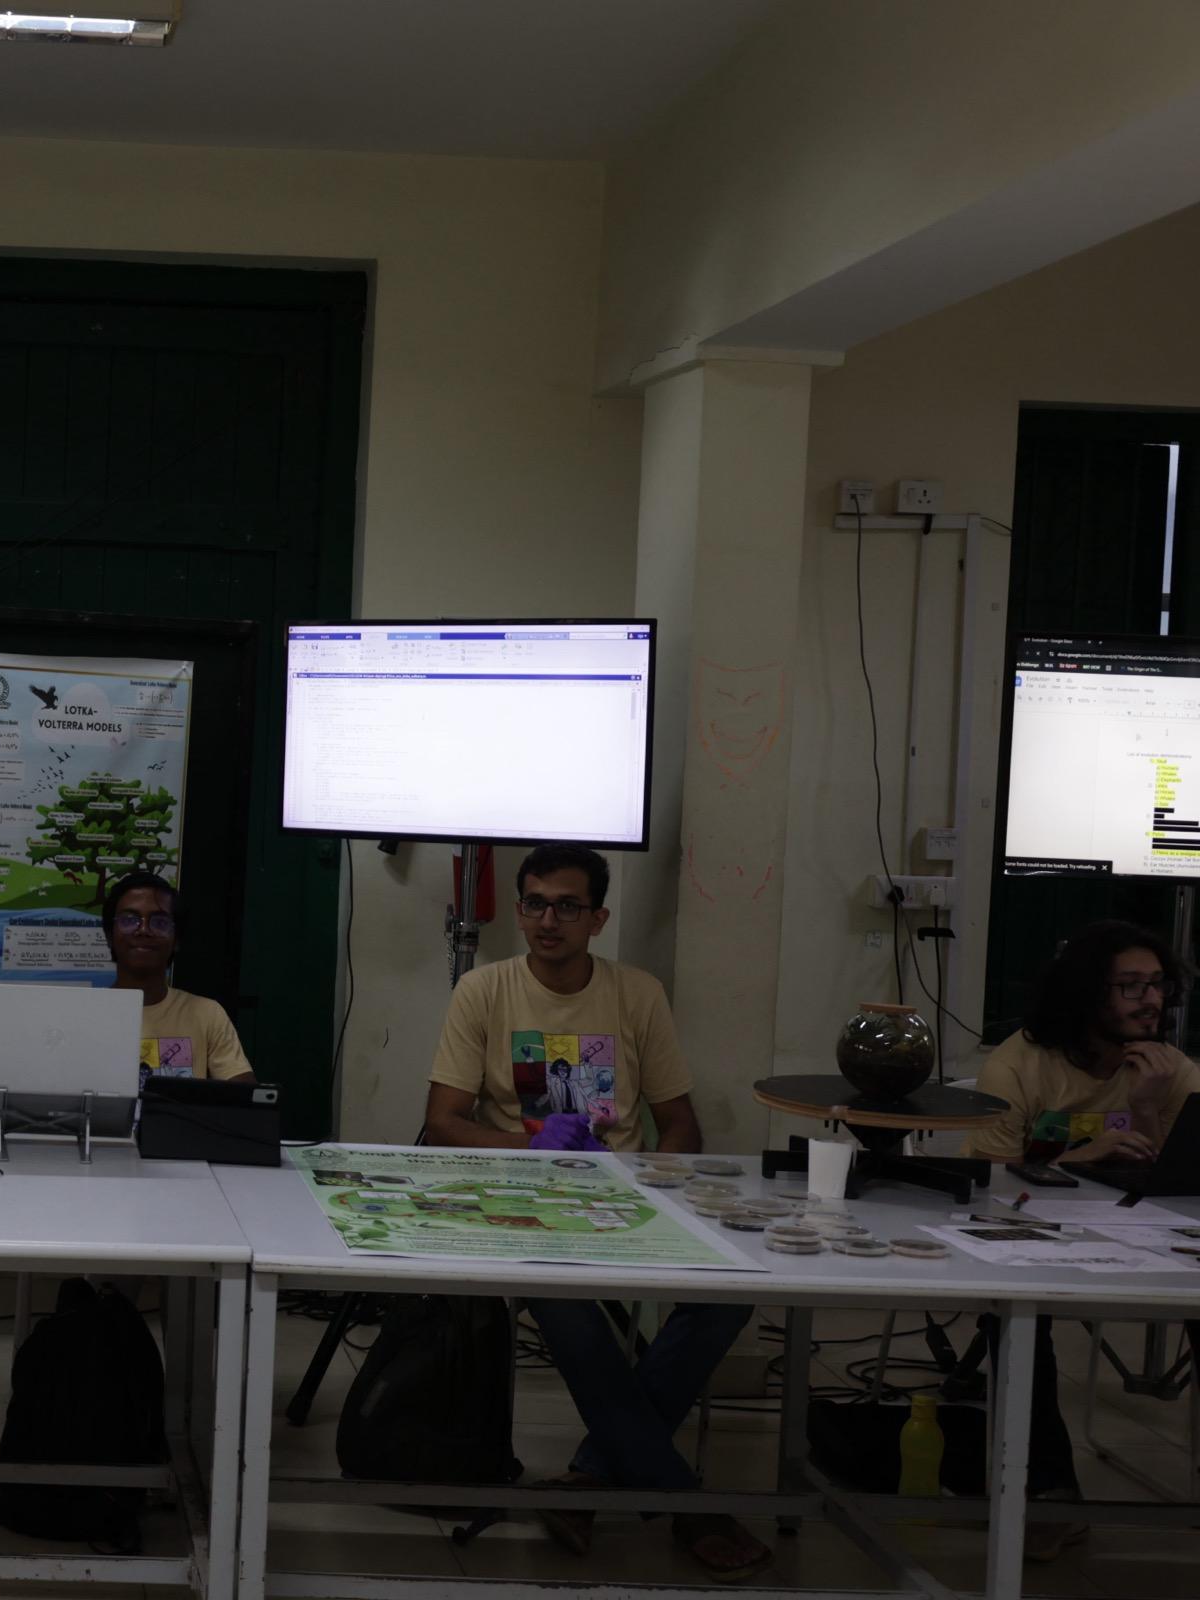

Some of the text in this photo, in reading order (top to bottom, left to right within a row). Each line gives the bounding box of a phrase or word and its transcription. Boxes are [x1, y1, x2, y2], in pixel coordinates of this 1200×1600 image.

[64, 705, 98, 717] LOTKA-
[38, 719, 84, 731] VOLTERRA
[86, 721, 122, 733] MODELS
[348, 1150, 396, 1158] Fungi
